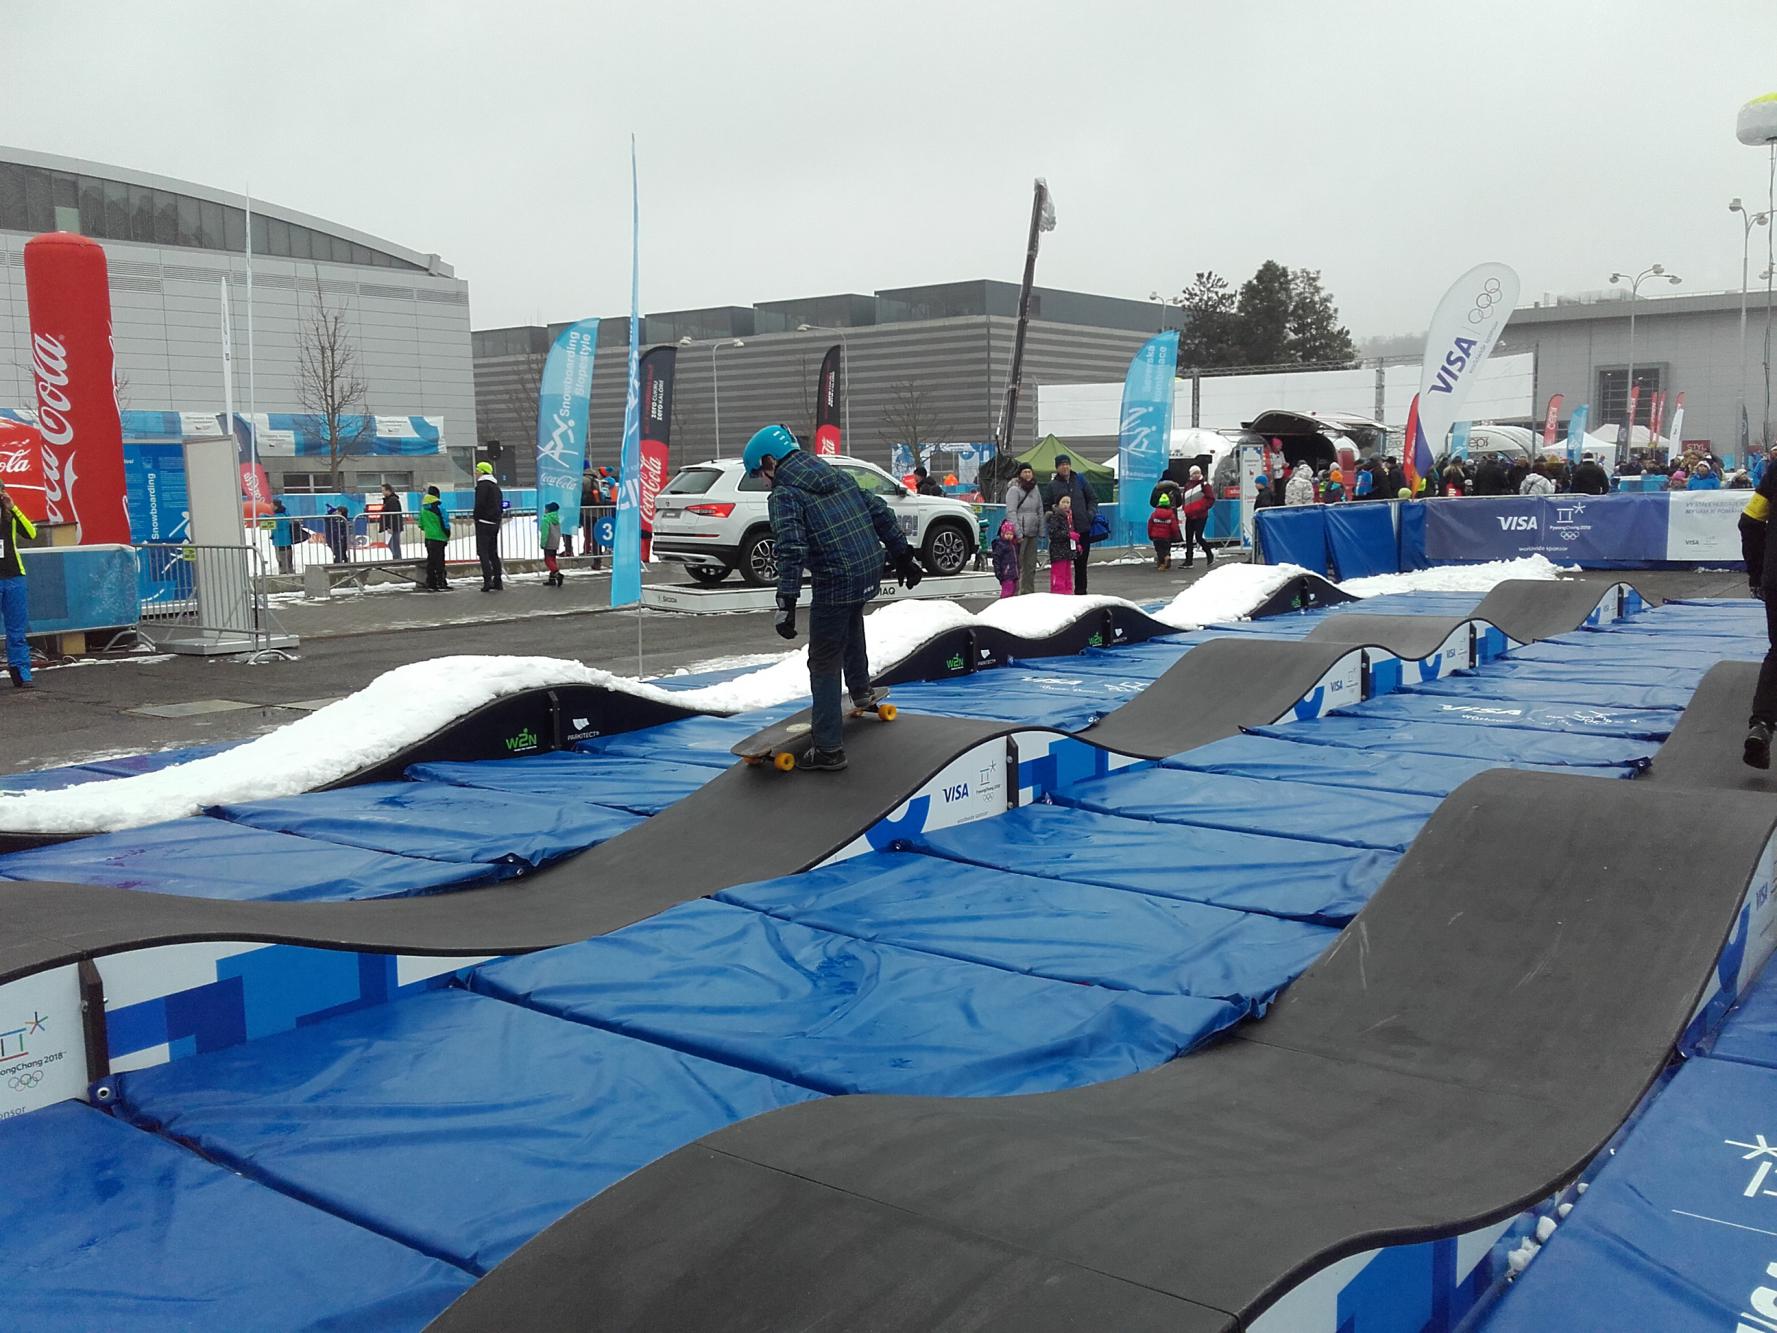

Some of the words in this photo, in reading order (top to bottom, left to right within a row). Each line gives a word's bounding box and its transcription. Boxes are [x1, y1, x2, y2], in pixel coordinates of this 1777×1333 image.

[560, 331, 580, 417] Snowboarding
[1427, 337, 1478, 395] VISA
[147, 473, 160, 540] Snowboarding
[602, 523, 613, 540] 3
[1496, 515, 1538, 531] VISA
[505, 732, 538, 750] W2N
[942, 783, 969, 803] VISA
